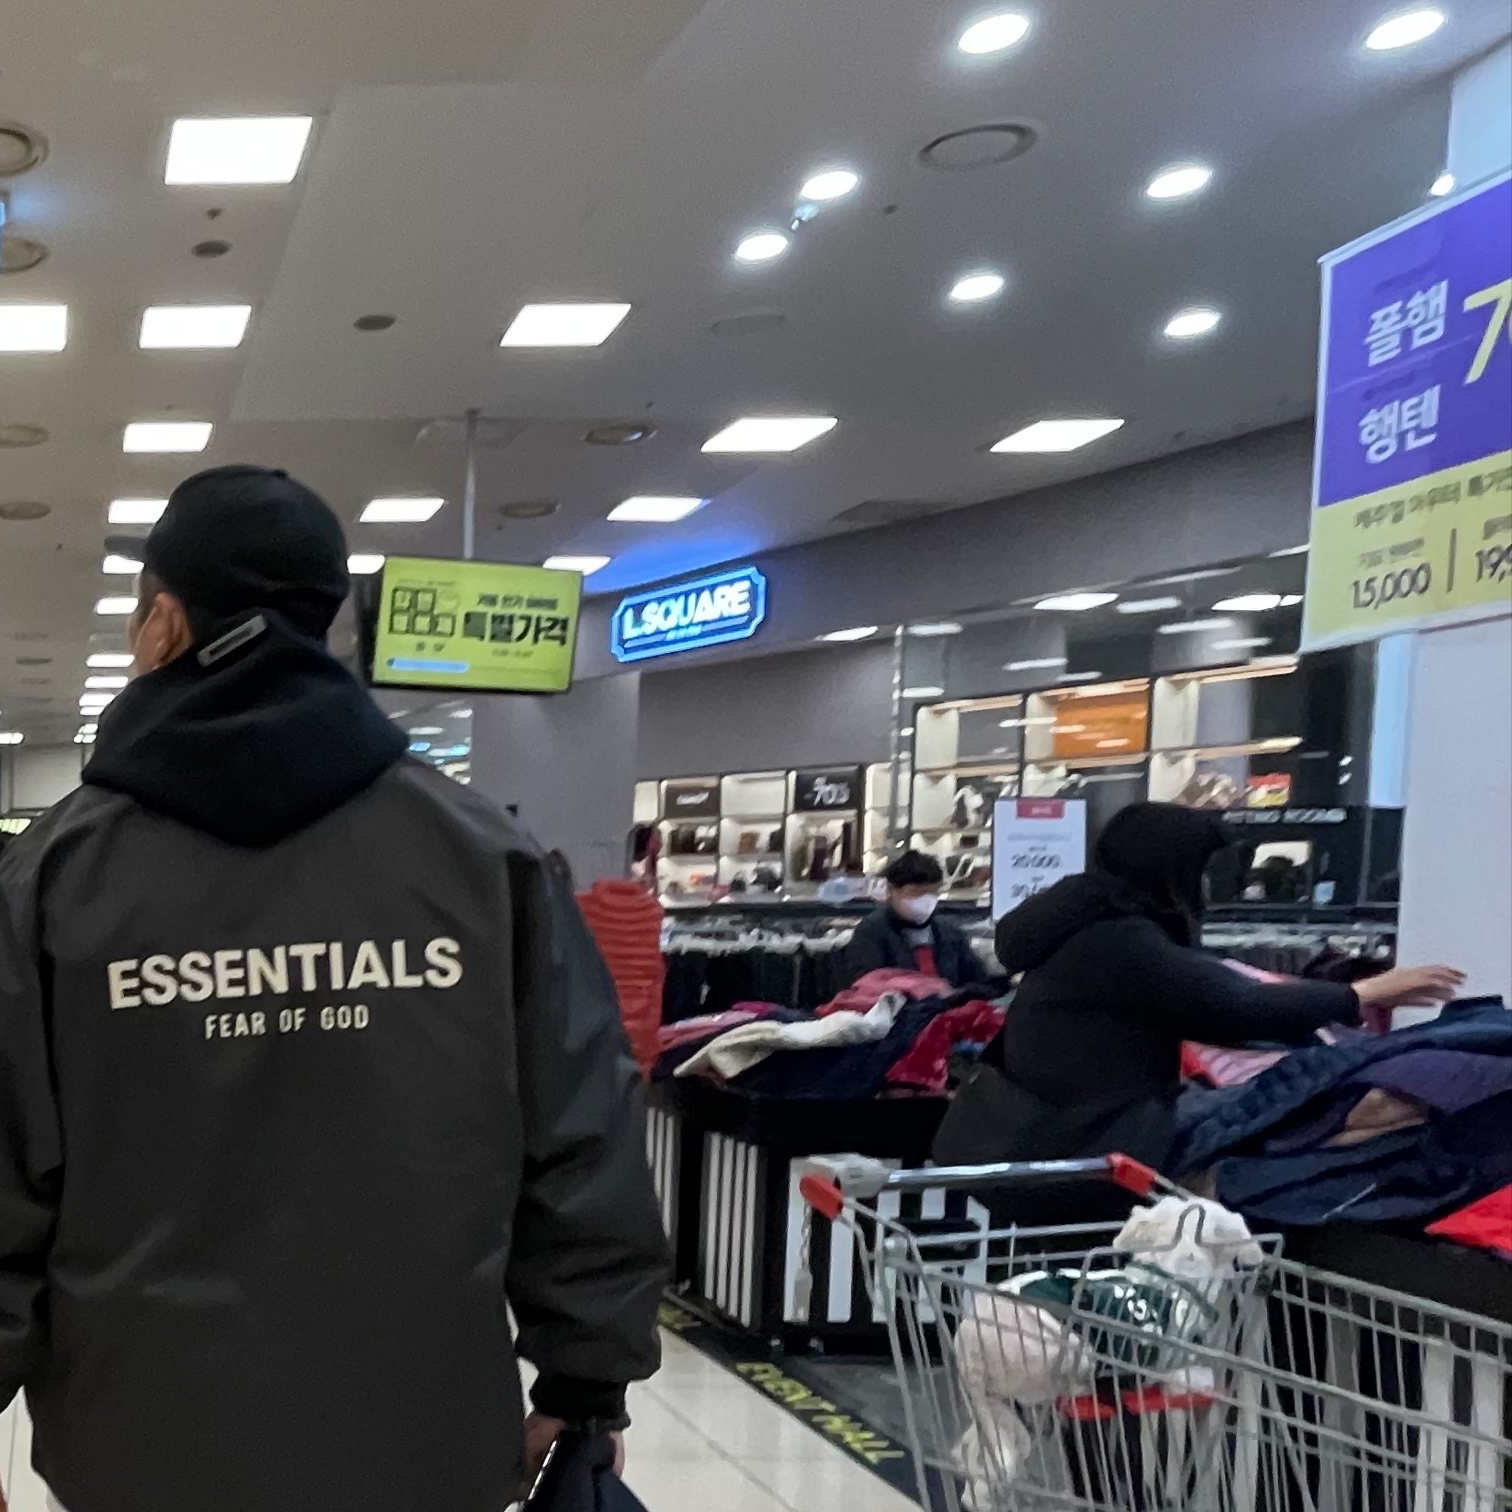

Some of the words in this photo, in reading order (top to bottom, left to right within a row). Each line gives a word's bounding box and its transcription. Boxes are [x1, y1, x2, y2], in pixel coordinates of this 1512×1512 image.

[1363, 277, 1449, 368] 폴햄
[1462, 277, 1512, 387] 7
[1358, 384, 1441, 464] 행텐
[1352, 561, 1432, 610] 15,000
[107, 936, 464, 1011] ESSENTIALS
[204, 1010, 267, 1040] FEAR
[278, 1007, 306, 1034] OF
[320, 1004, 370, 1031] GOD
